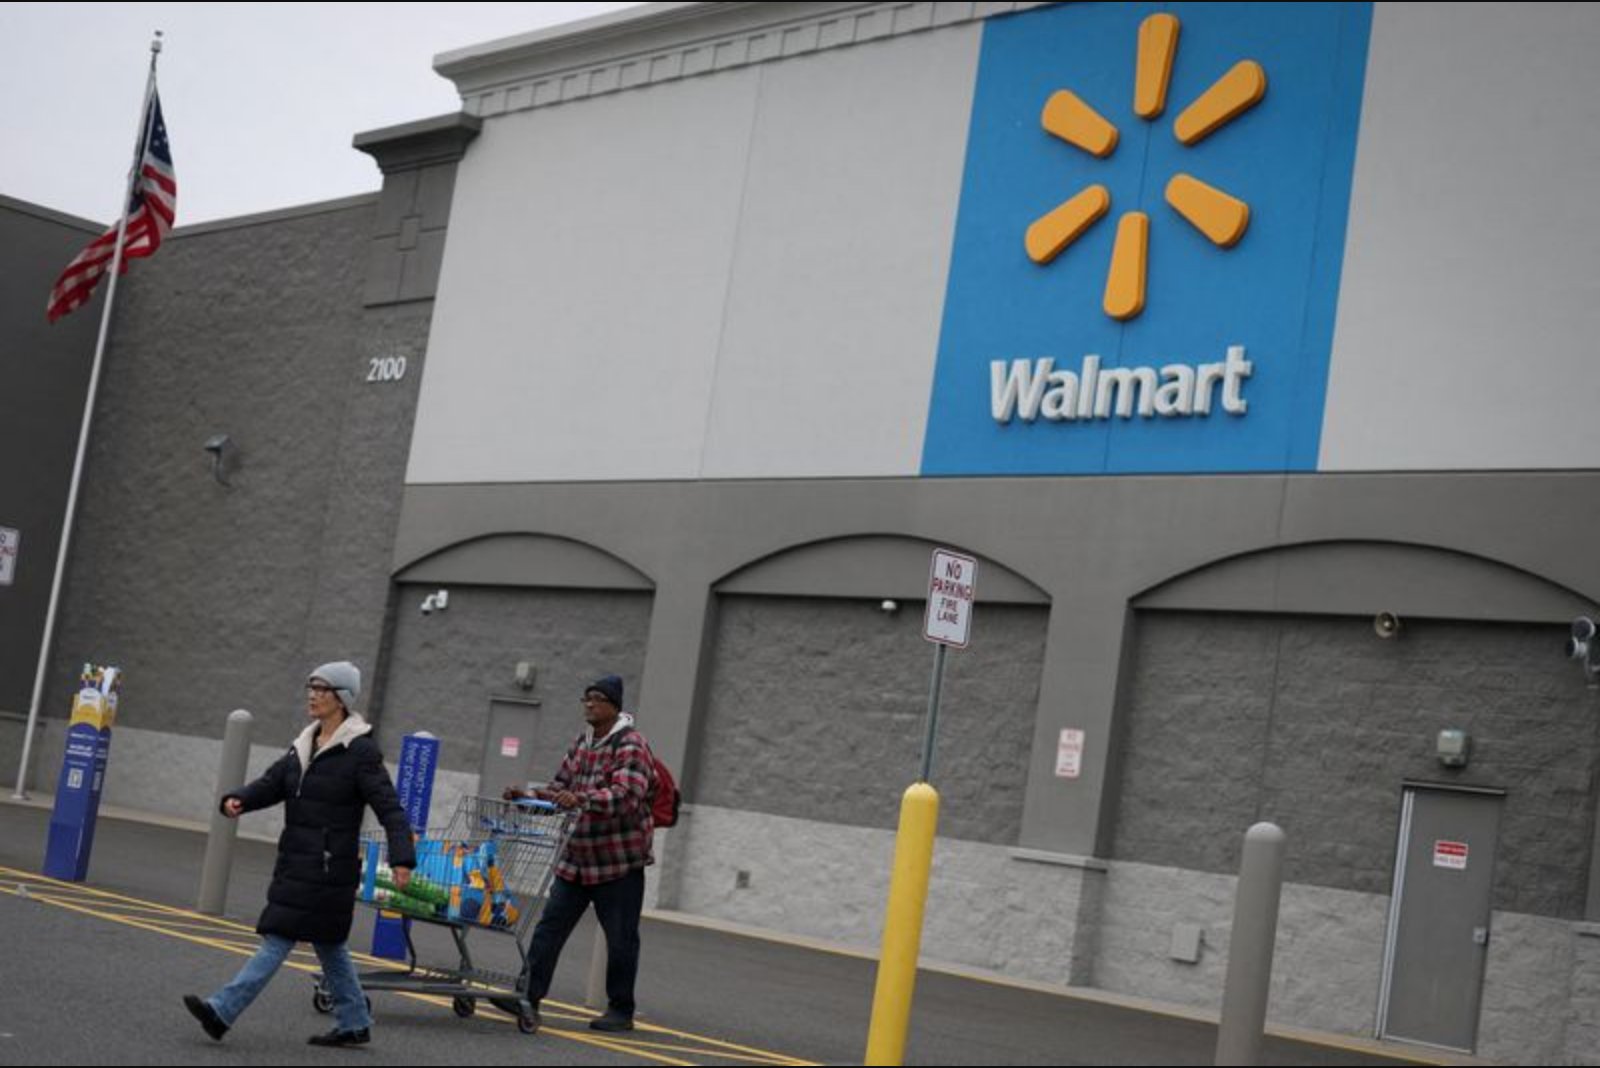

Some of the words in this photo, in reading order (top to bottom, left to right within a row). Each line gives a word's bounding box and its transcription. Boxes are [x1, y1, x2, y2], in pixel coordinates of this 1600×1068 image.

[367, 356, 406, 381] 2100
[990, 346, 1251, 424] Walmart
[945, 560, 962, 580] NO
[933, 577, 975, 603] PARKING
[940, 596, 958, 613] FIRE
[937, 609, 959, 625] LANE
